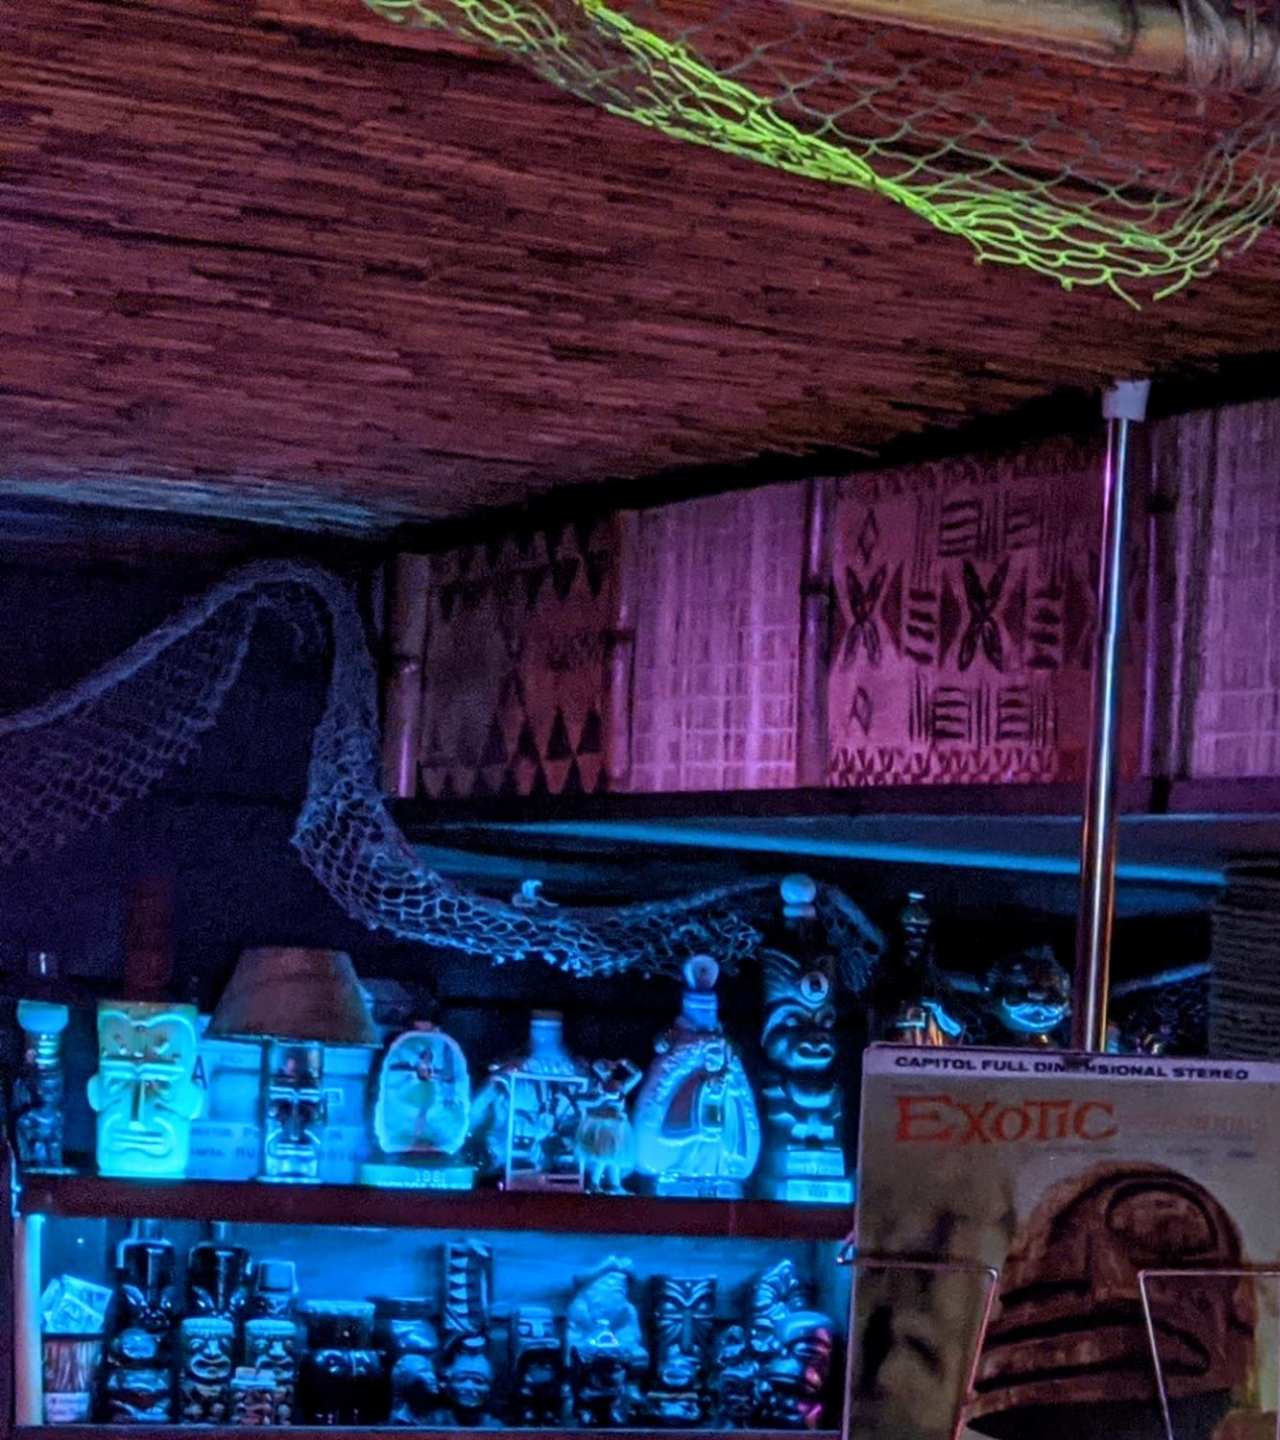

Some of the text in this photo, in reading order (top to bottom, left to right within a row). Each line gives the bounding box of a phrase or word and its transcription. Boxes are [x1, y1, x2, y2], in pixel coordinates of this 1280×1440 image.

[895, 1056, 976, 1070] CAPITOL
[981, 1060, 1028, 1072] FULL
[1172, 1067, 1249, 1080] STEREO
